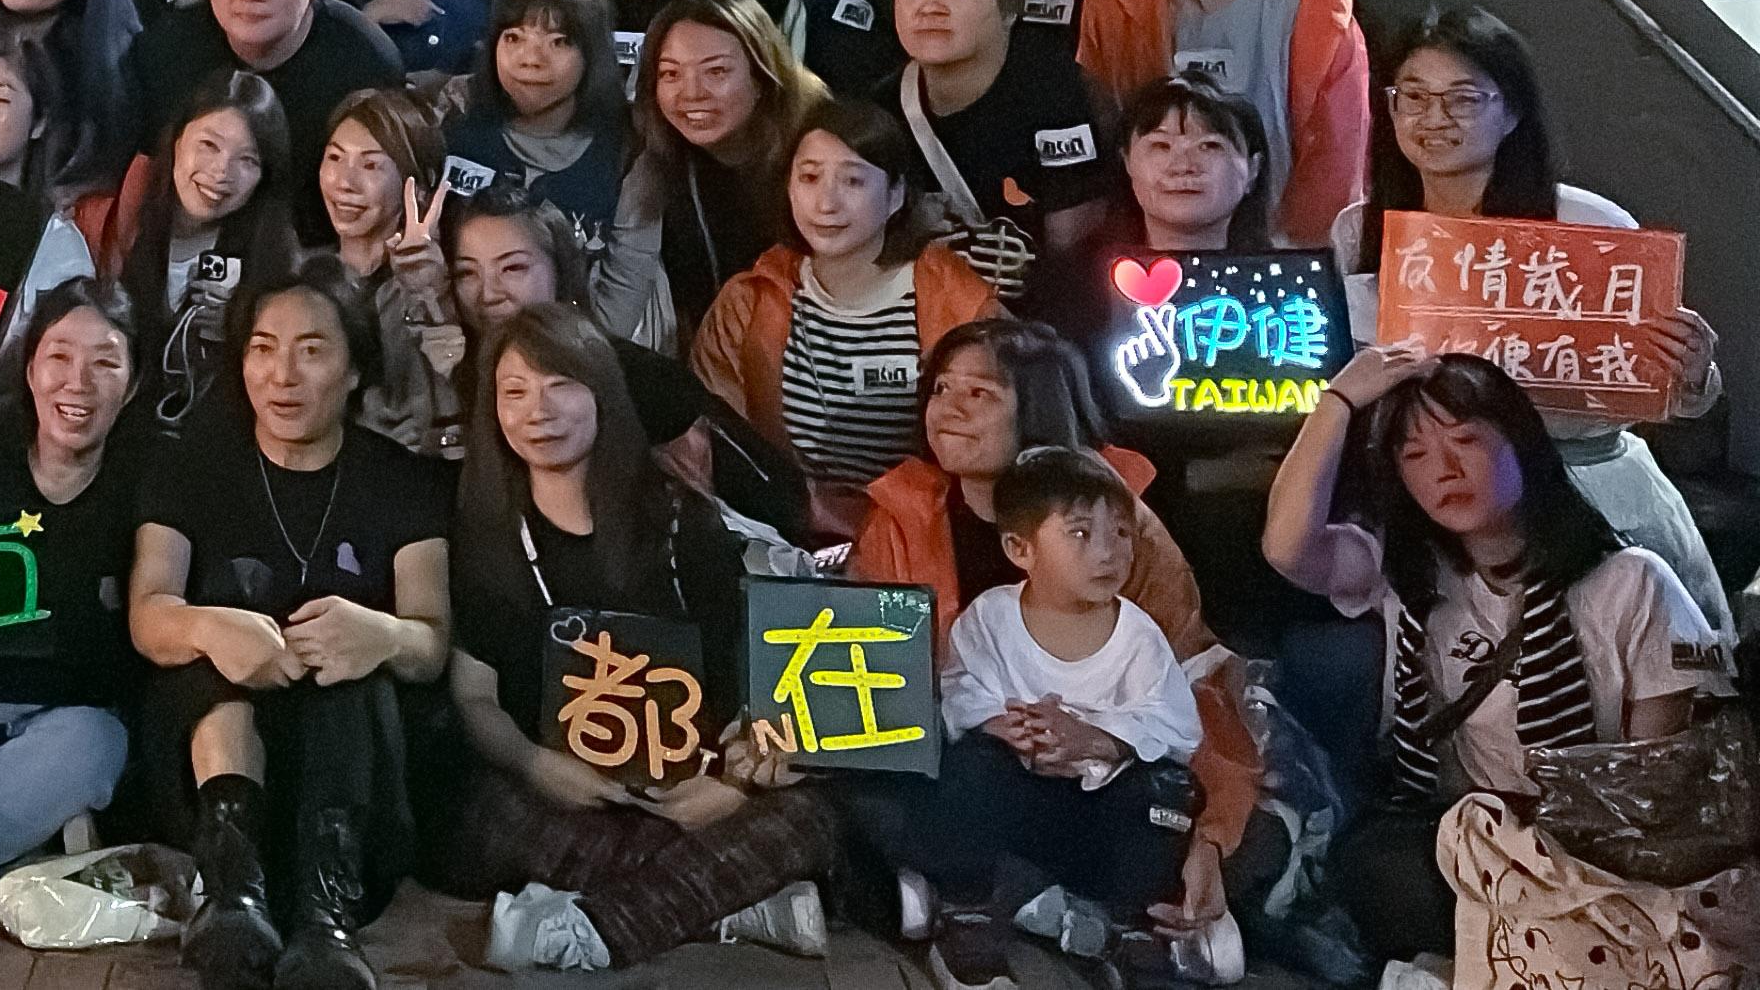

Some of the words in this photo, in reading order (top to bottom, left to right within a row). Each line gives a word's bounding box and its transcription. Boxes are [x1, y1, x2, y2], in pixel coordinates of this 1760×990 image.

[1176, 295, 1329, 369] 伊健
[557, 630, 703, 780] 都
[763, 608, 925, 752] 在
